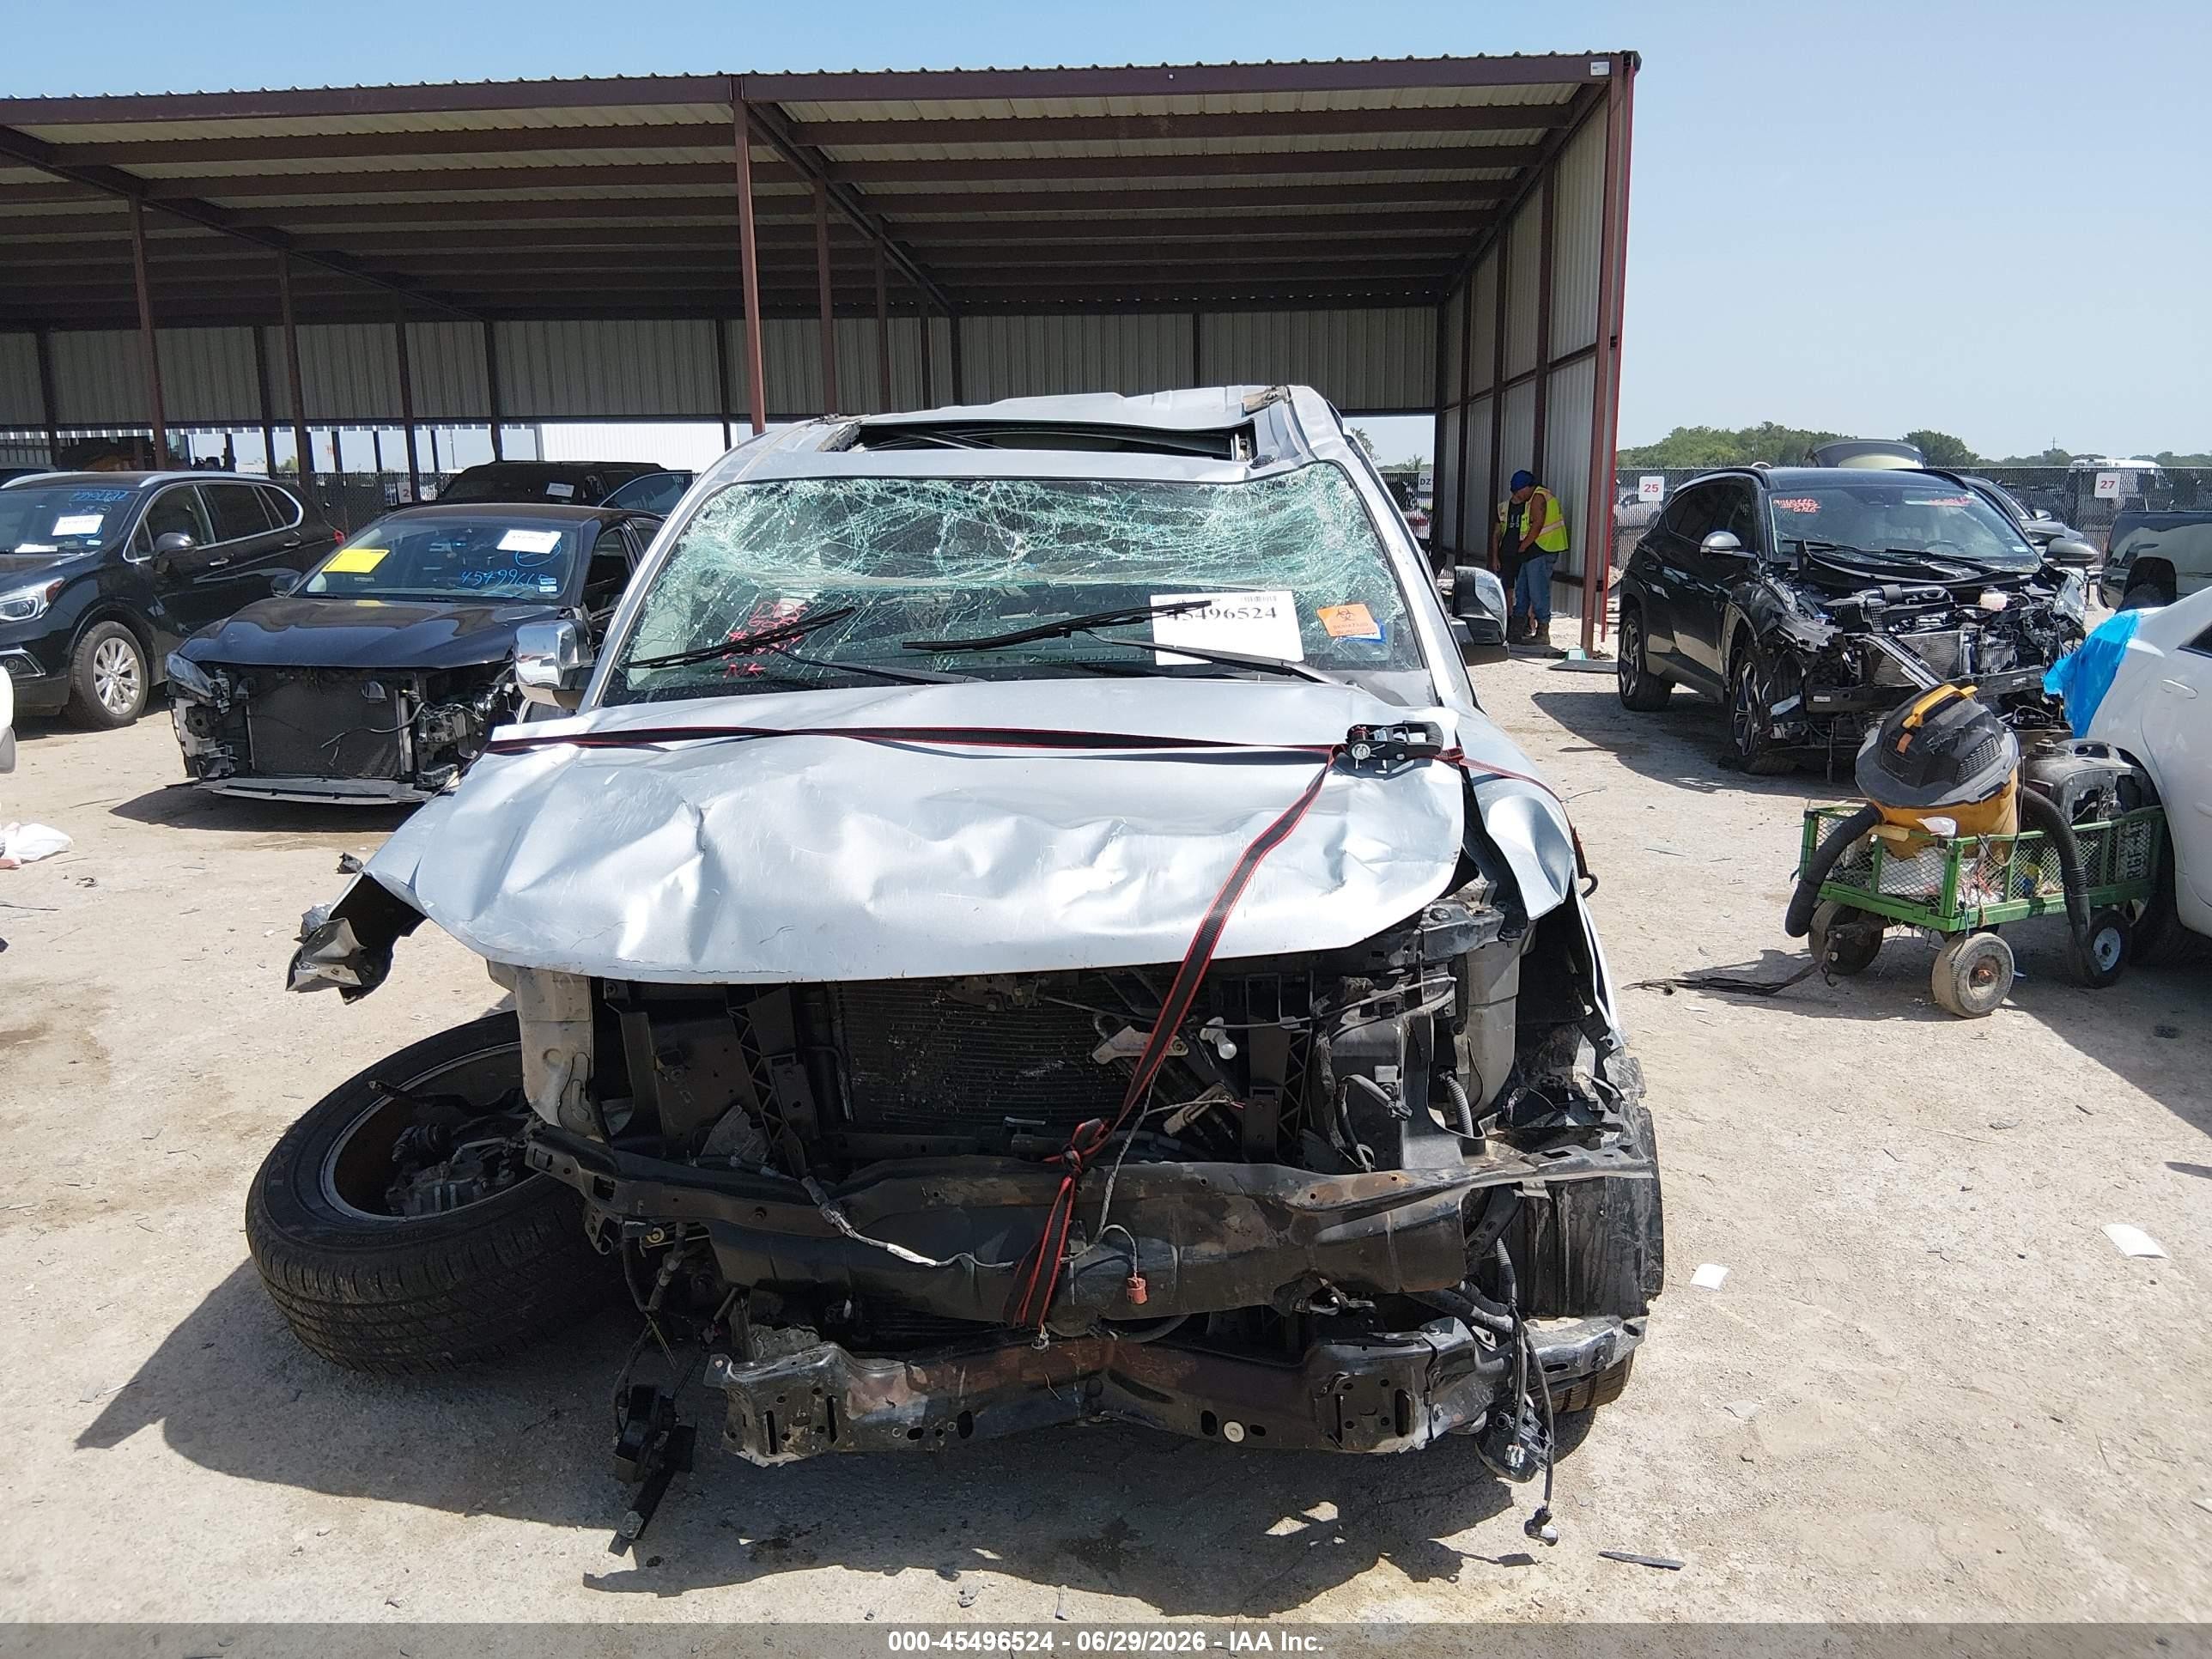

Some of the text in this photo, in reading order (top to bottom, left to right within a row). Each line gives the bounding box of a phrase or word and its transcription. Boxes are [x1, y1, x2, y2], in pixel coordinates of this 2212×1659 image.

[1644, 483, 1659, 493] 25
[2100, 480, 2116, 489] 27
[1167, 606, 1278, 621] 45496524
